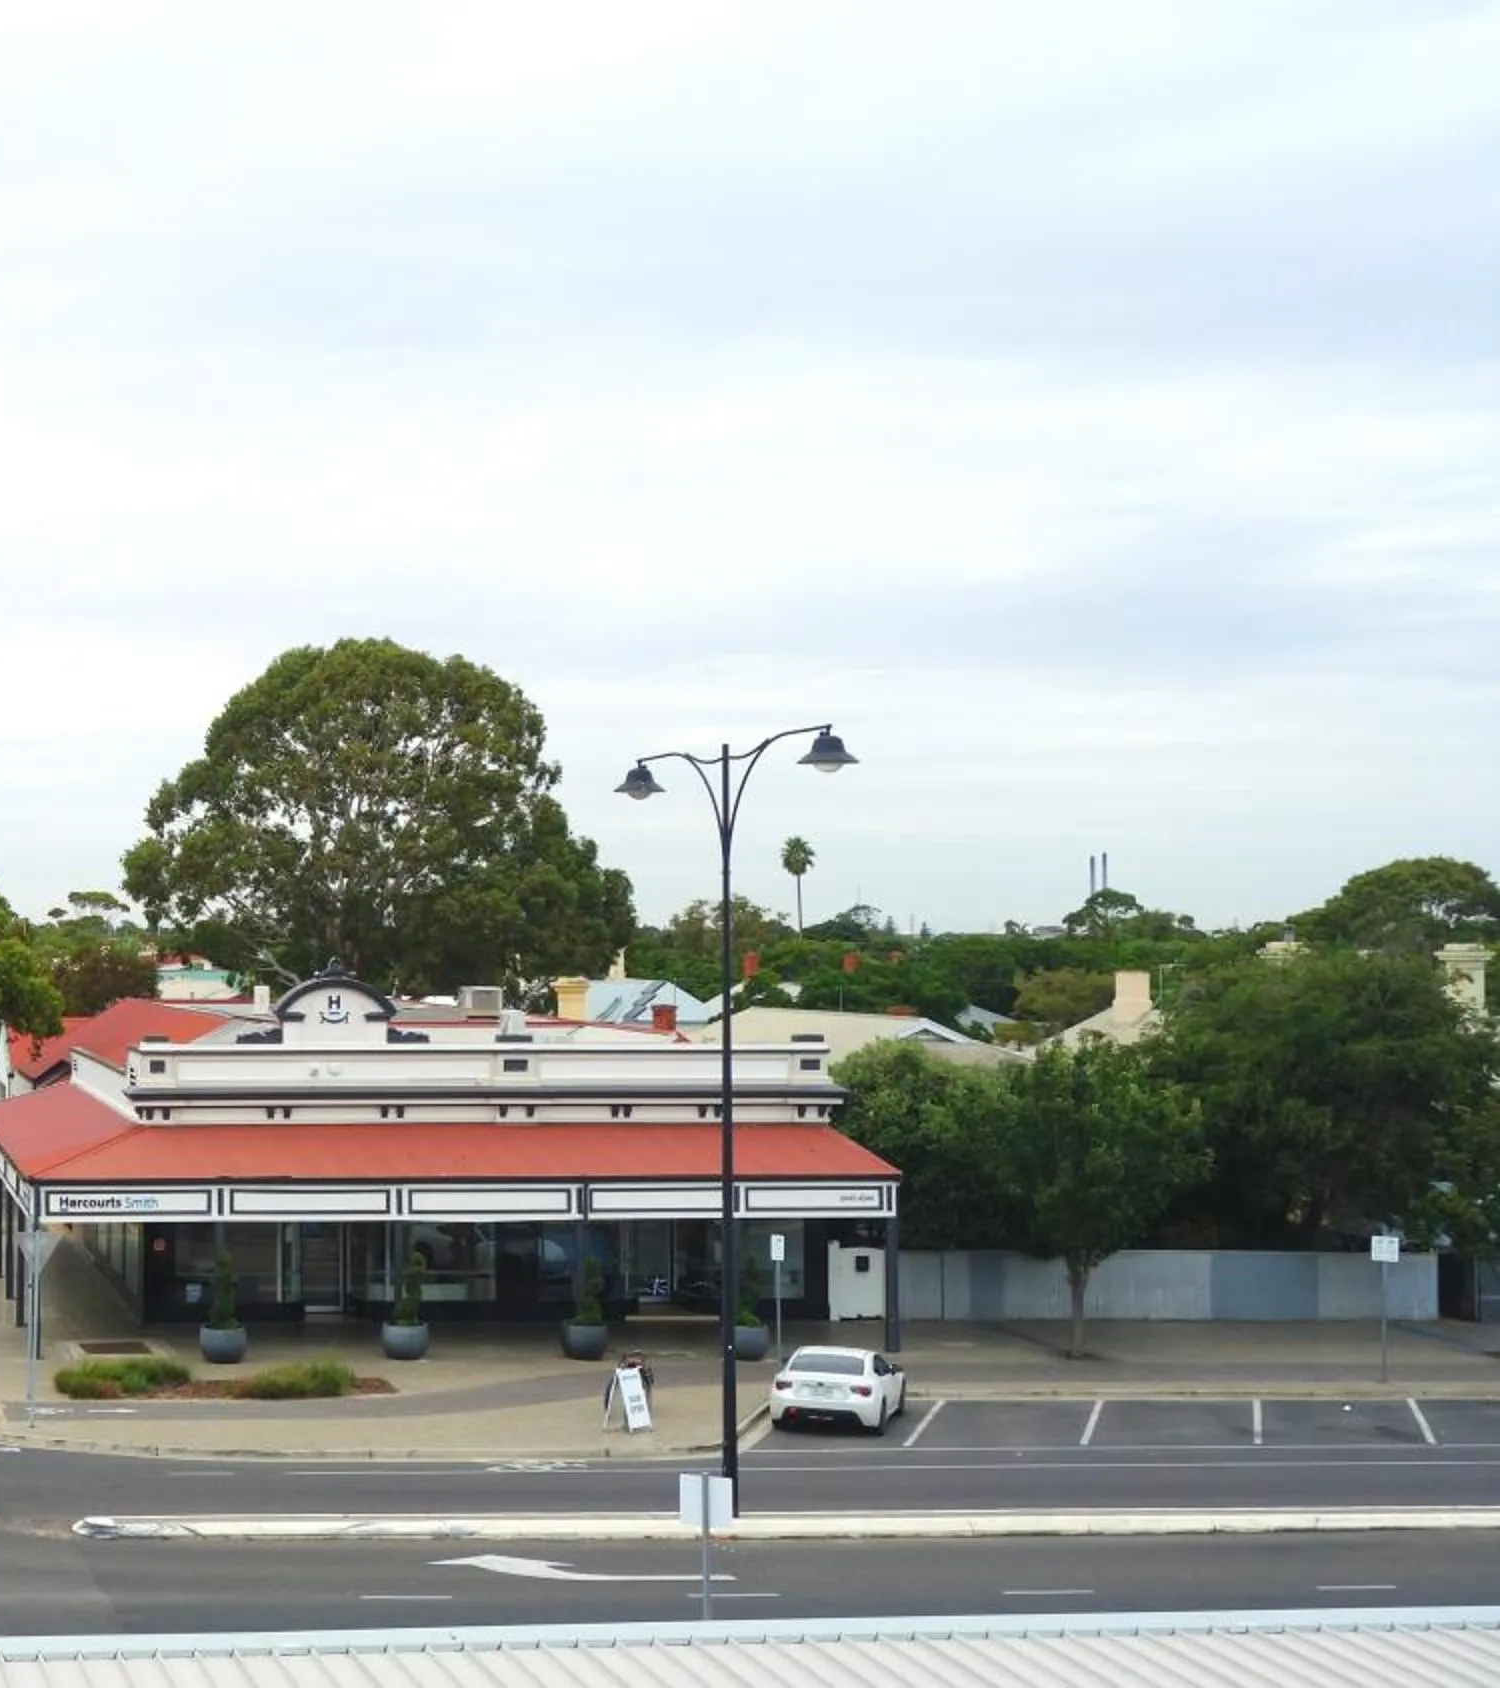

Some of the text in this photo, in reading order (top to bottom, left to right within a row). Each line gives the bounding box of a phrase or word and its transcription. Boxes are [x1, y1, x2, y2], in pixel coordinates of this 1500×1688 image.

[328, 995, 341, 1009] H
[59, 1196, 159, 1209] Harcourts Smith
